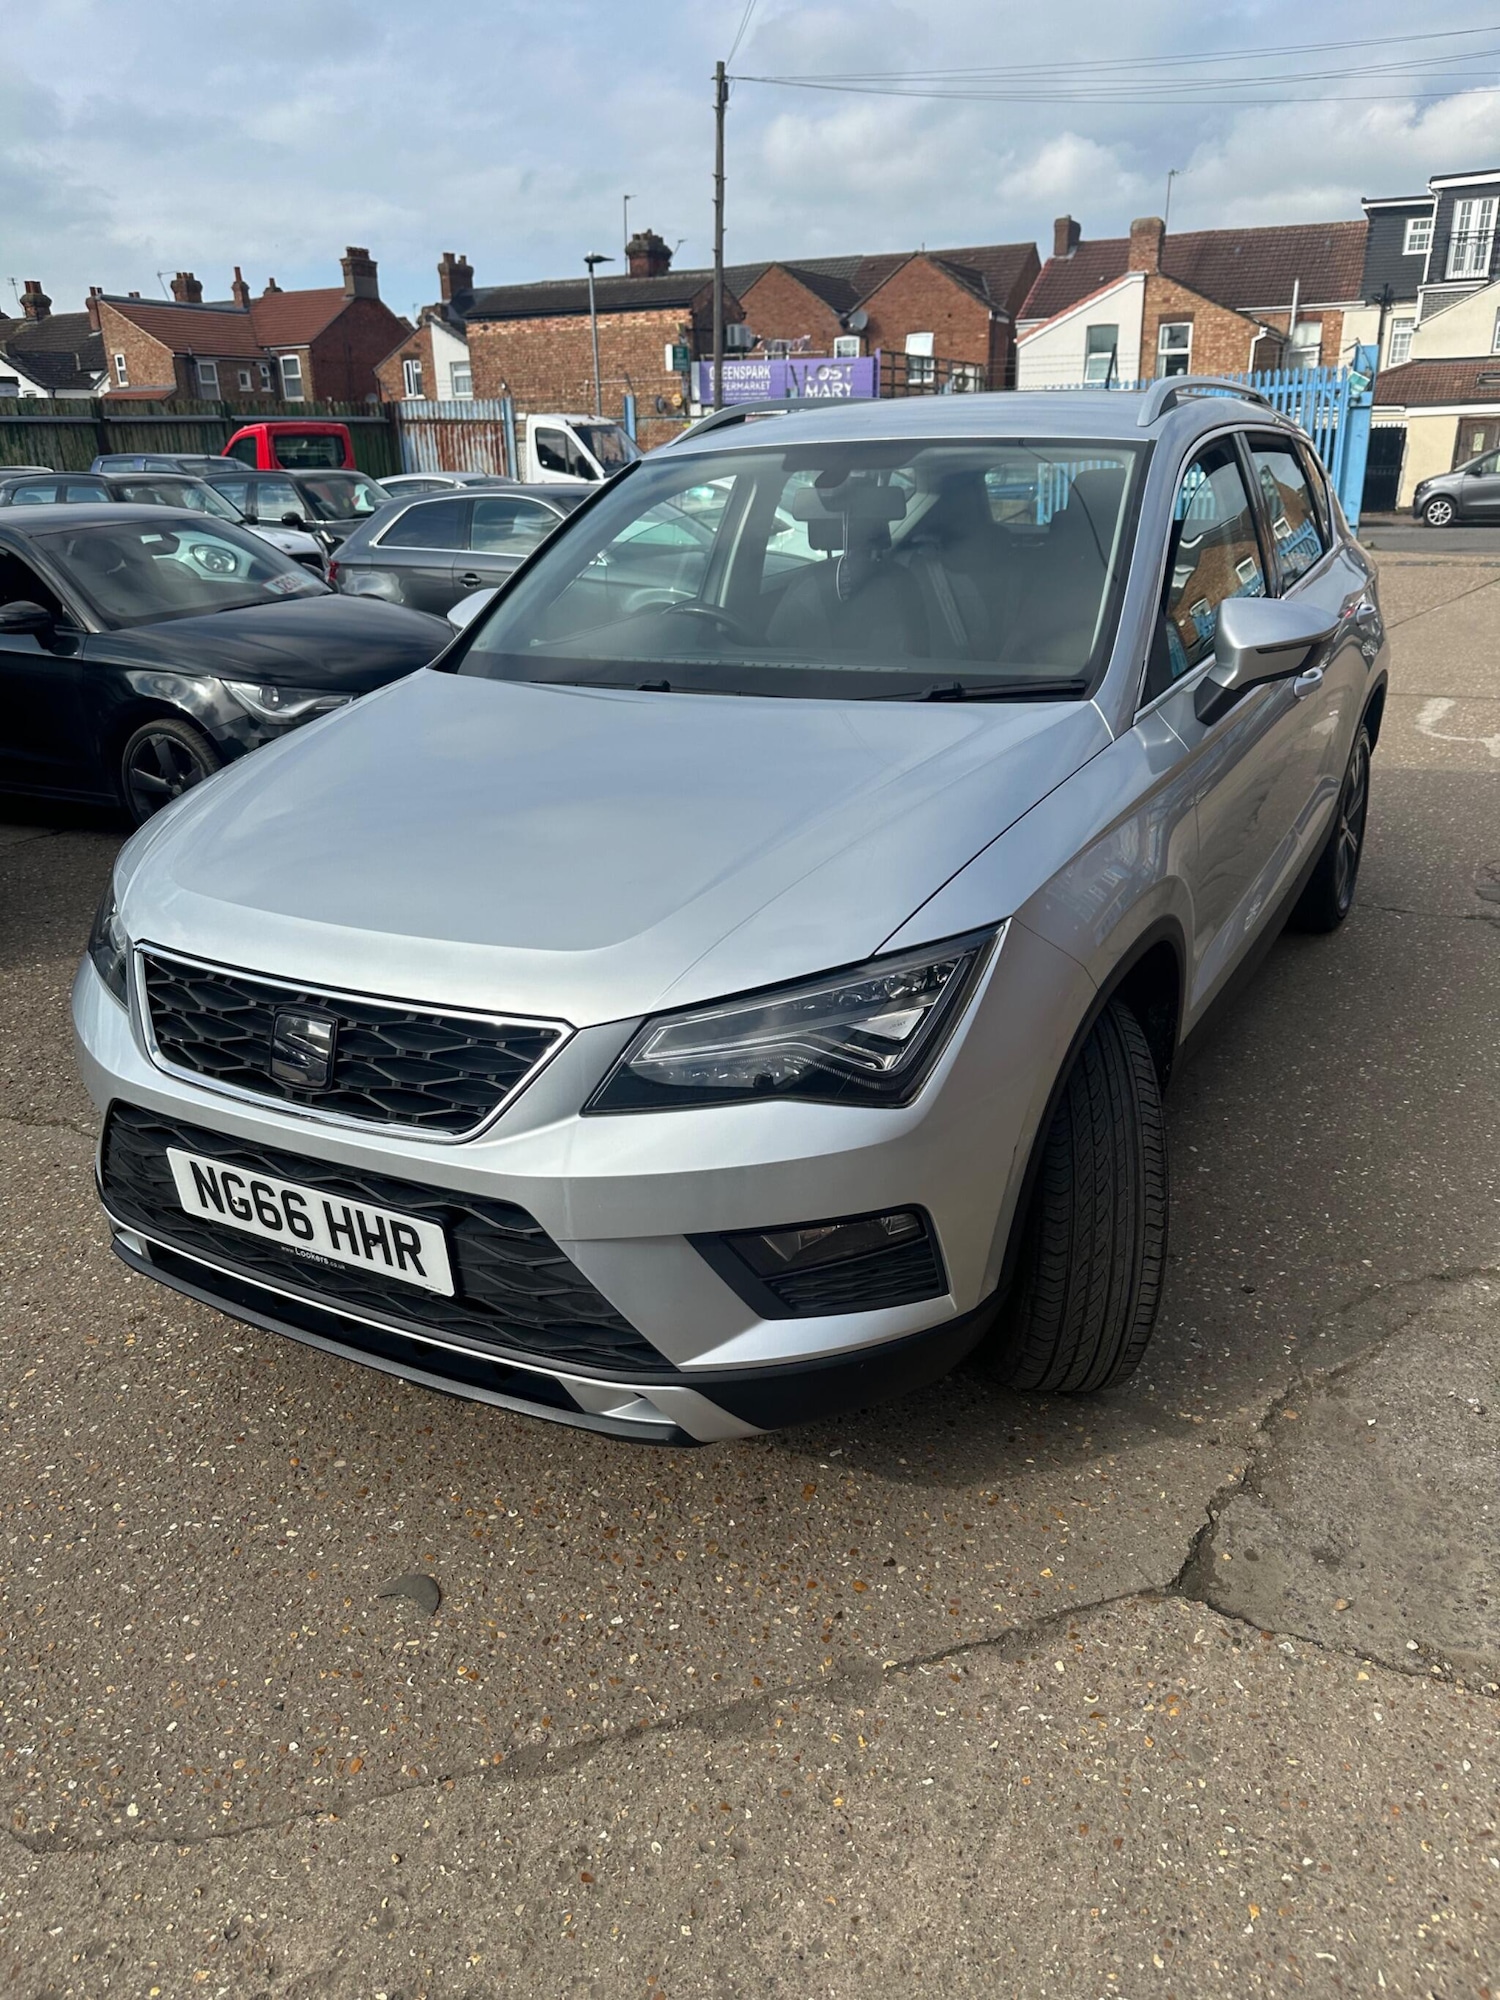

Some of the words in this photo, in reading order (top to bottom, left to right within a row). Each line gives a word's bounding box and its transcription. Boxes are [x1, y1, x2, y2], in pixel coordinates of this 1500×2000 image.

[709, 365, 771, 380] QEENSPARK
[804, 364, 854, 381] LOST
[709, 381, 771, 392] SPERMARKET
[804, 382, 853, 398] MARY
[189, 1160, 314, 1241] NG66
[322, 1200, 428, 1278] HHR
